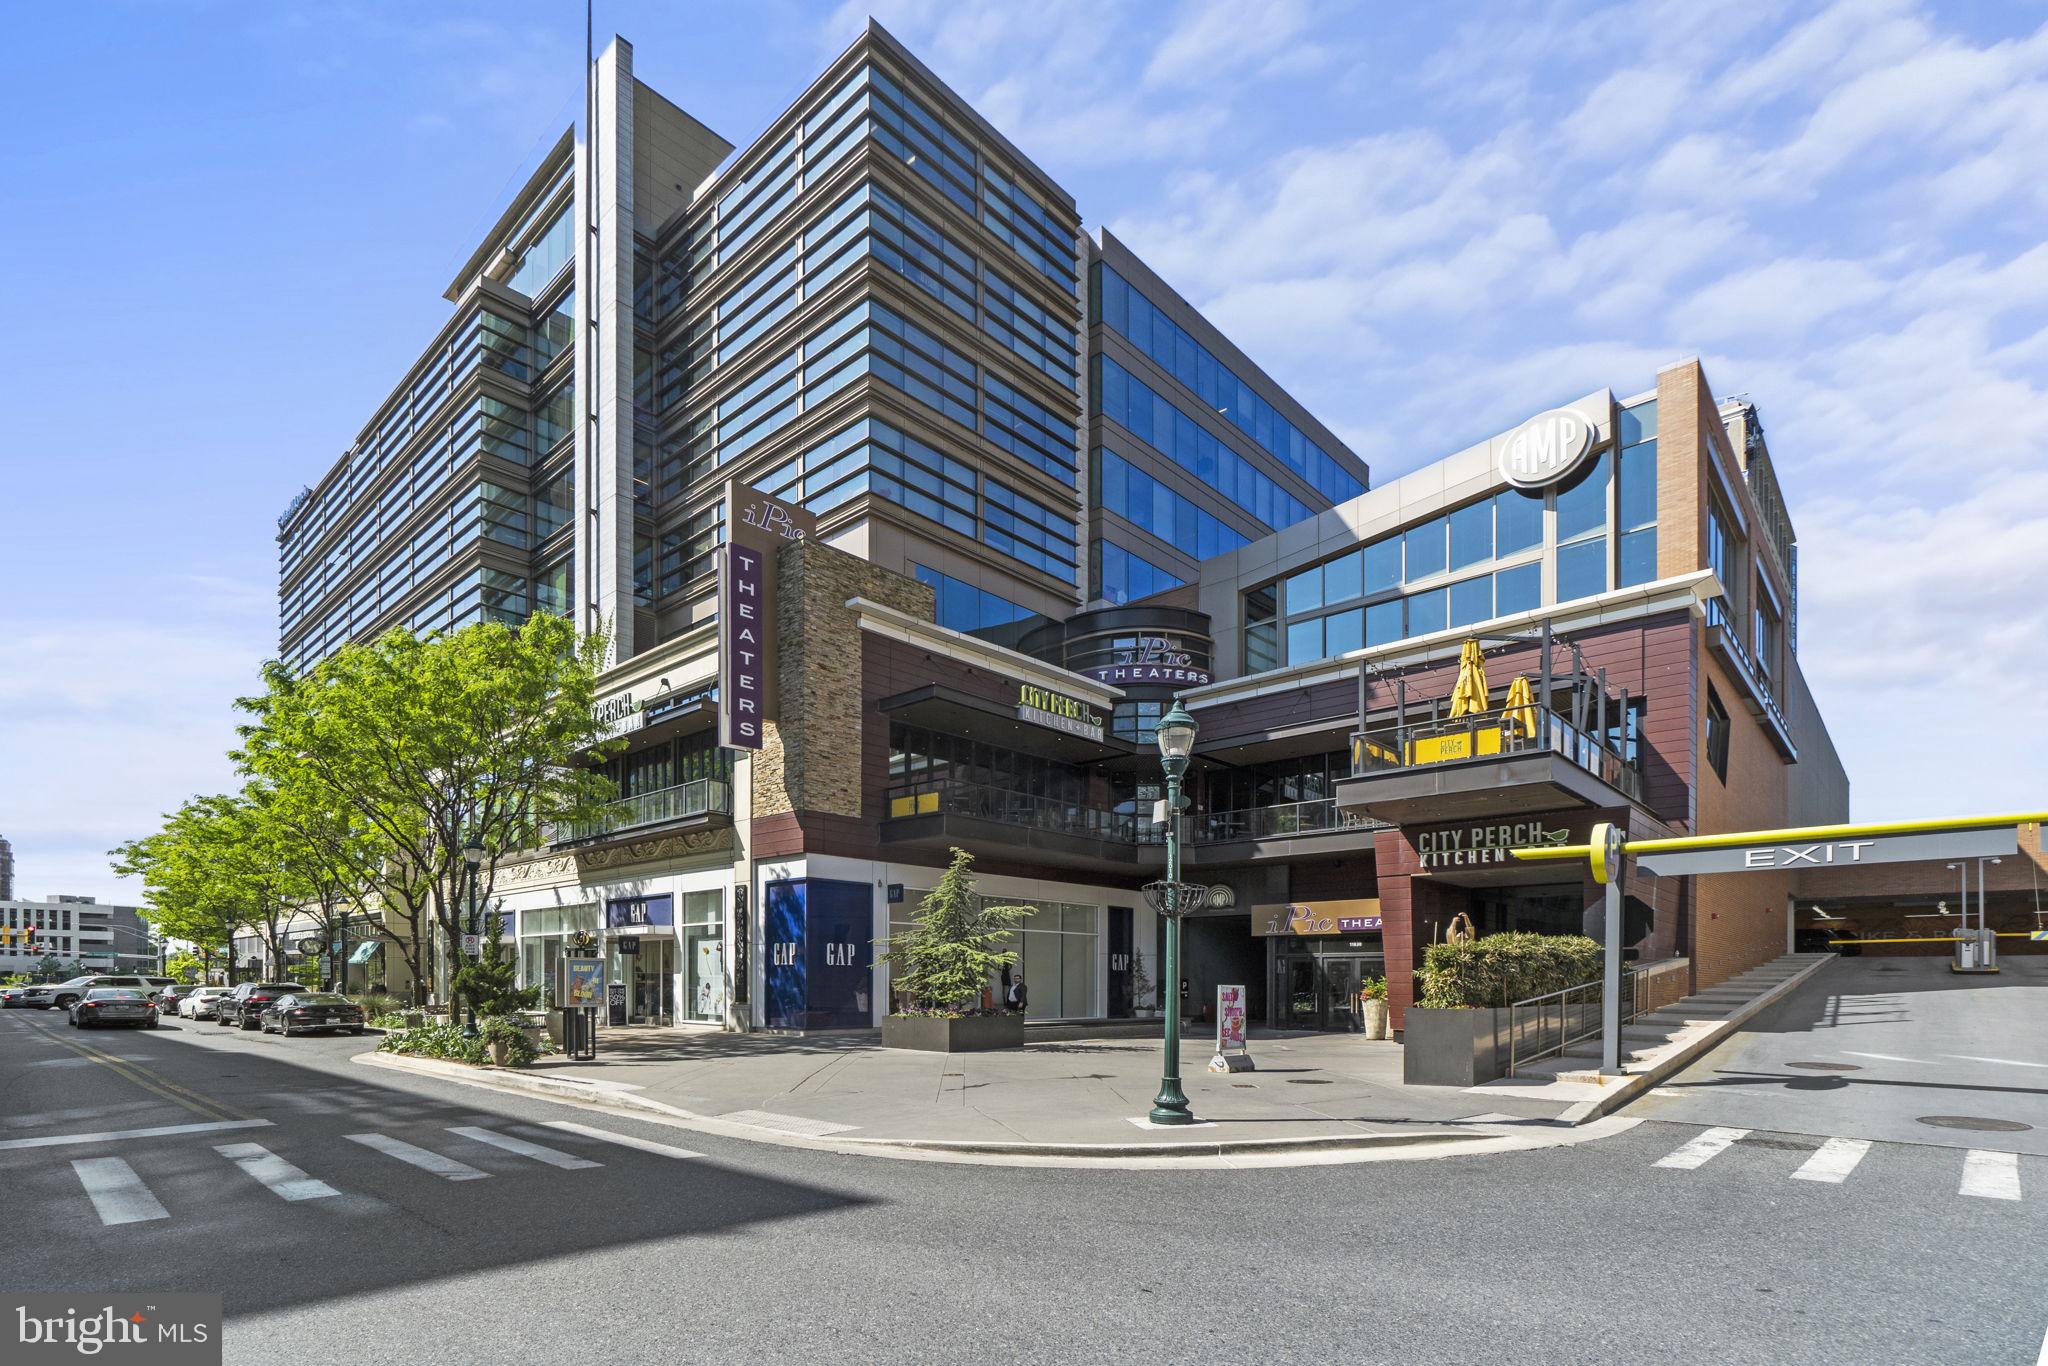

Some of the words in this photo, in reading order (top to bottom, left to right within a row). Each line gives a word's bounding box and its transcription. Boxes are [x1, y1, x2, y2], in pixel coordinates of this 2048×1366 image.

[1511, 416, 1576, 474] AMP
[738, 555, 756, 737] THEATERS
[1099, 668, 1208, 684] THEATERS
[597, 693, 632, 722] PERCH
[1021, 685, 1050, 711] CITY
[1025, 706, 1073, 731] KITCHEN
[1083, 722, 1104, 740] BAR
[1440, 738, 1455, 748] CITY
[1440, 744, 1462, 755] PERCH
[1419, 829, 1463, 852] CITY
[1472, 822, 1542, 848] PERCH
[1419, 848, 1505, 868] KITCHEN
[1745, 842, 1875, 868] EXIT
[630, 902, 647, 923] GAP
[773, 942, 797, 966] GAP
[826, 942, 856, 966] GAP
[1112, 953, 1129, 971] GAP
